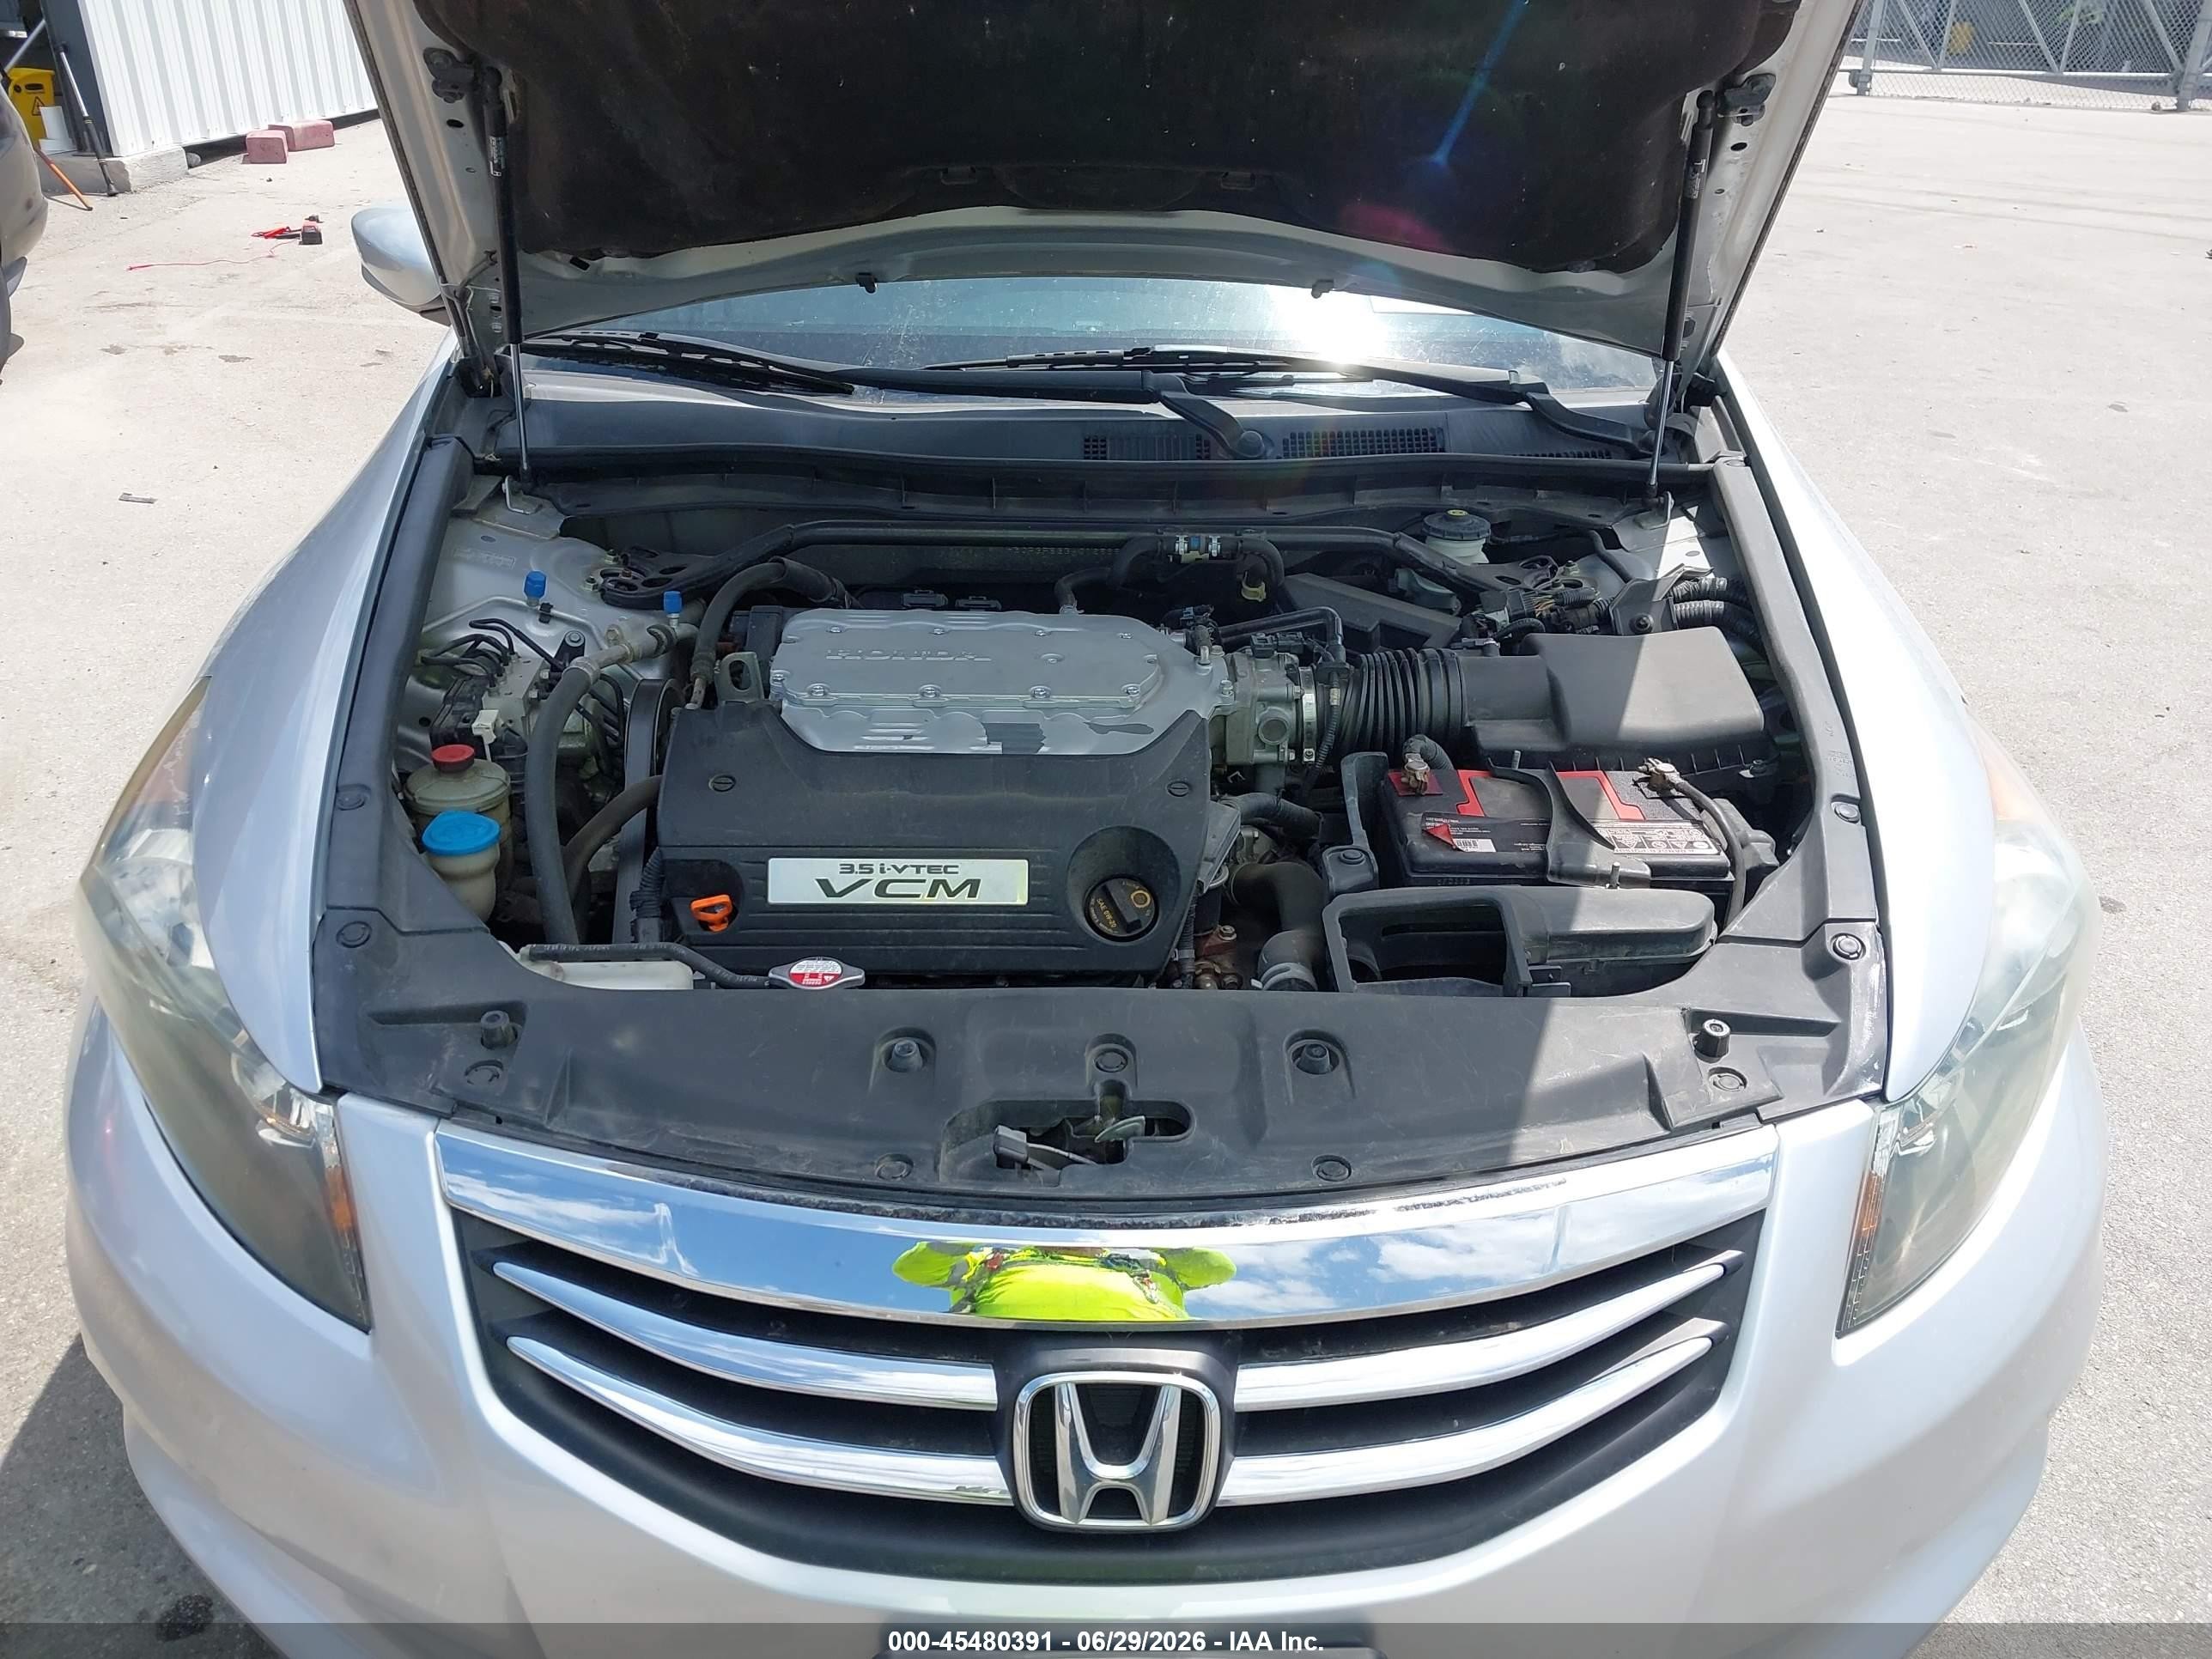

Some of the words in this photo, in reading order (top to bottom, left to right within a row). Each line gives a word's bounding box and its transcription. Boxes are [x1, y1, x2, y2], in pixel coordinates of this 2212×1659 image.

[839, 863, 874, 874] 3.5
[878, 863, 959, 874] i-VTEC
[815, 878, 981, 898] VCM
